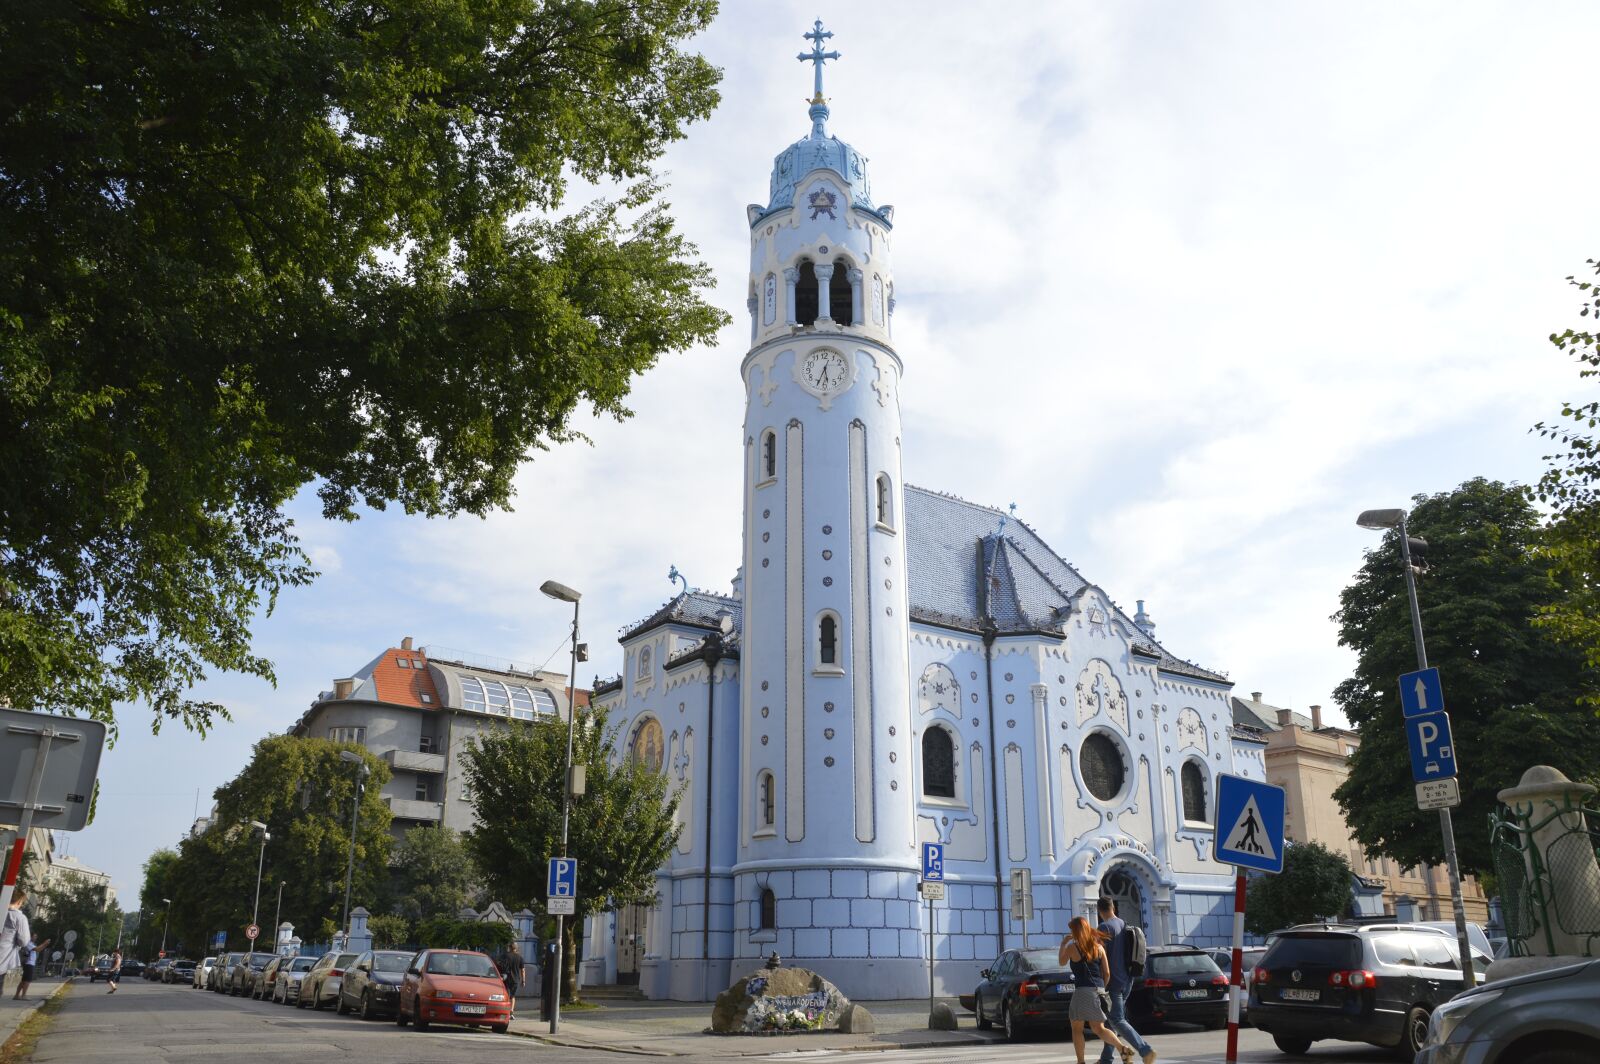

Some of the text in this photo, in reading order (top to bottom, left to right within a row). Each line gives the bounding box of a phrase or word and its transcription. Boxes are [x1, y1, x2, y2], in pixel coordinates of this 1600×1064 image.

[1418, 721, 1438, 757] P
[929, 846, 938, 867] P
[557, 861, 568, 881] P
